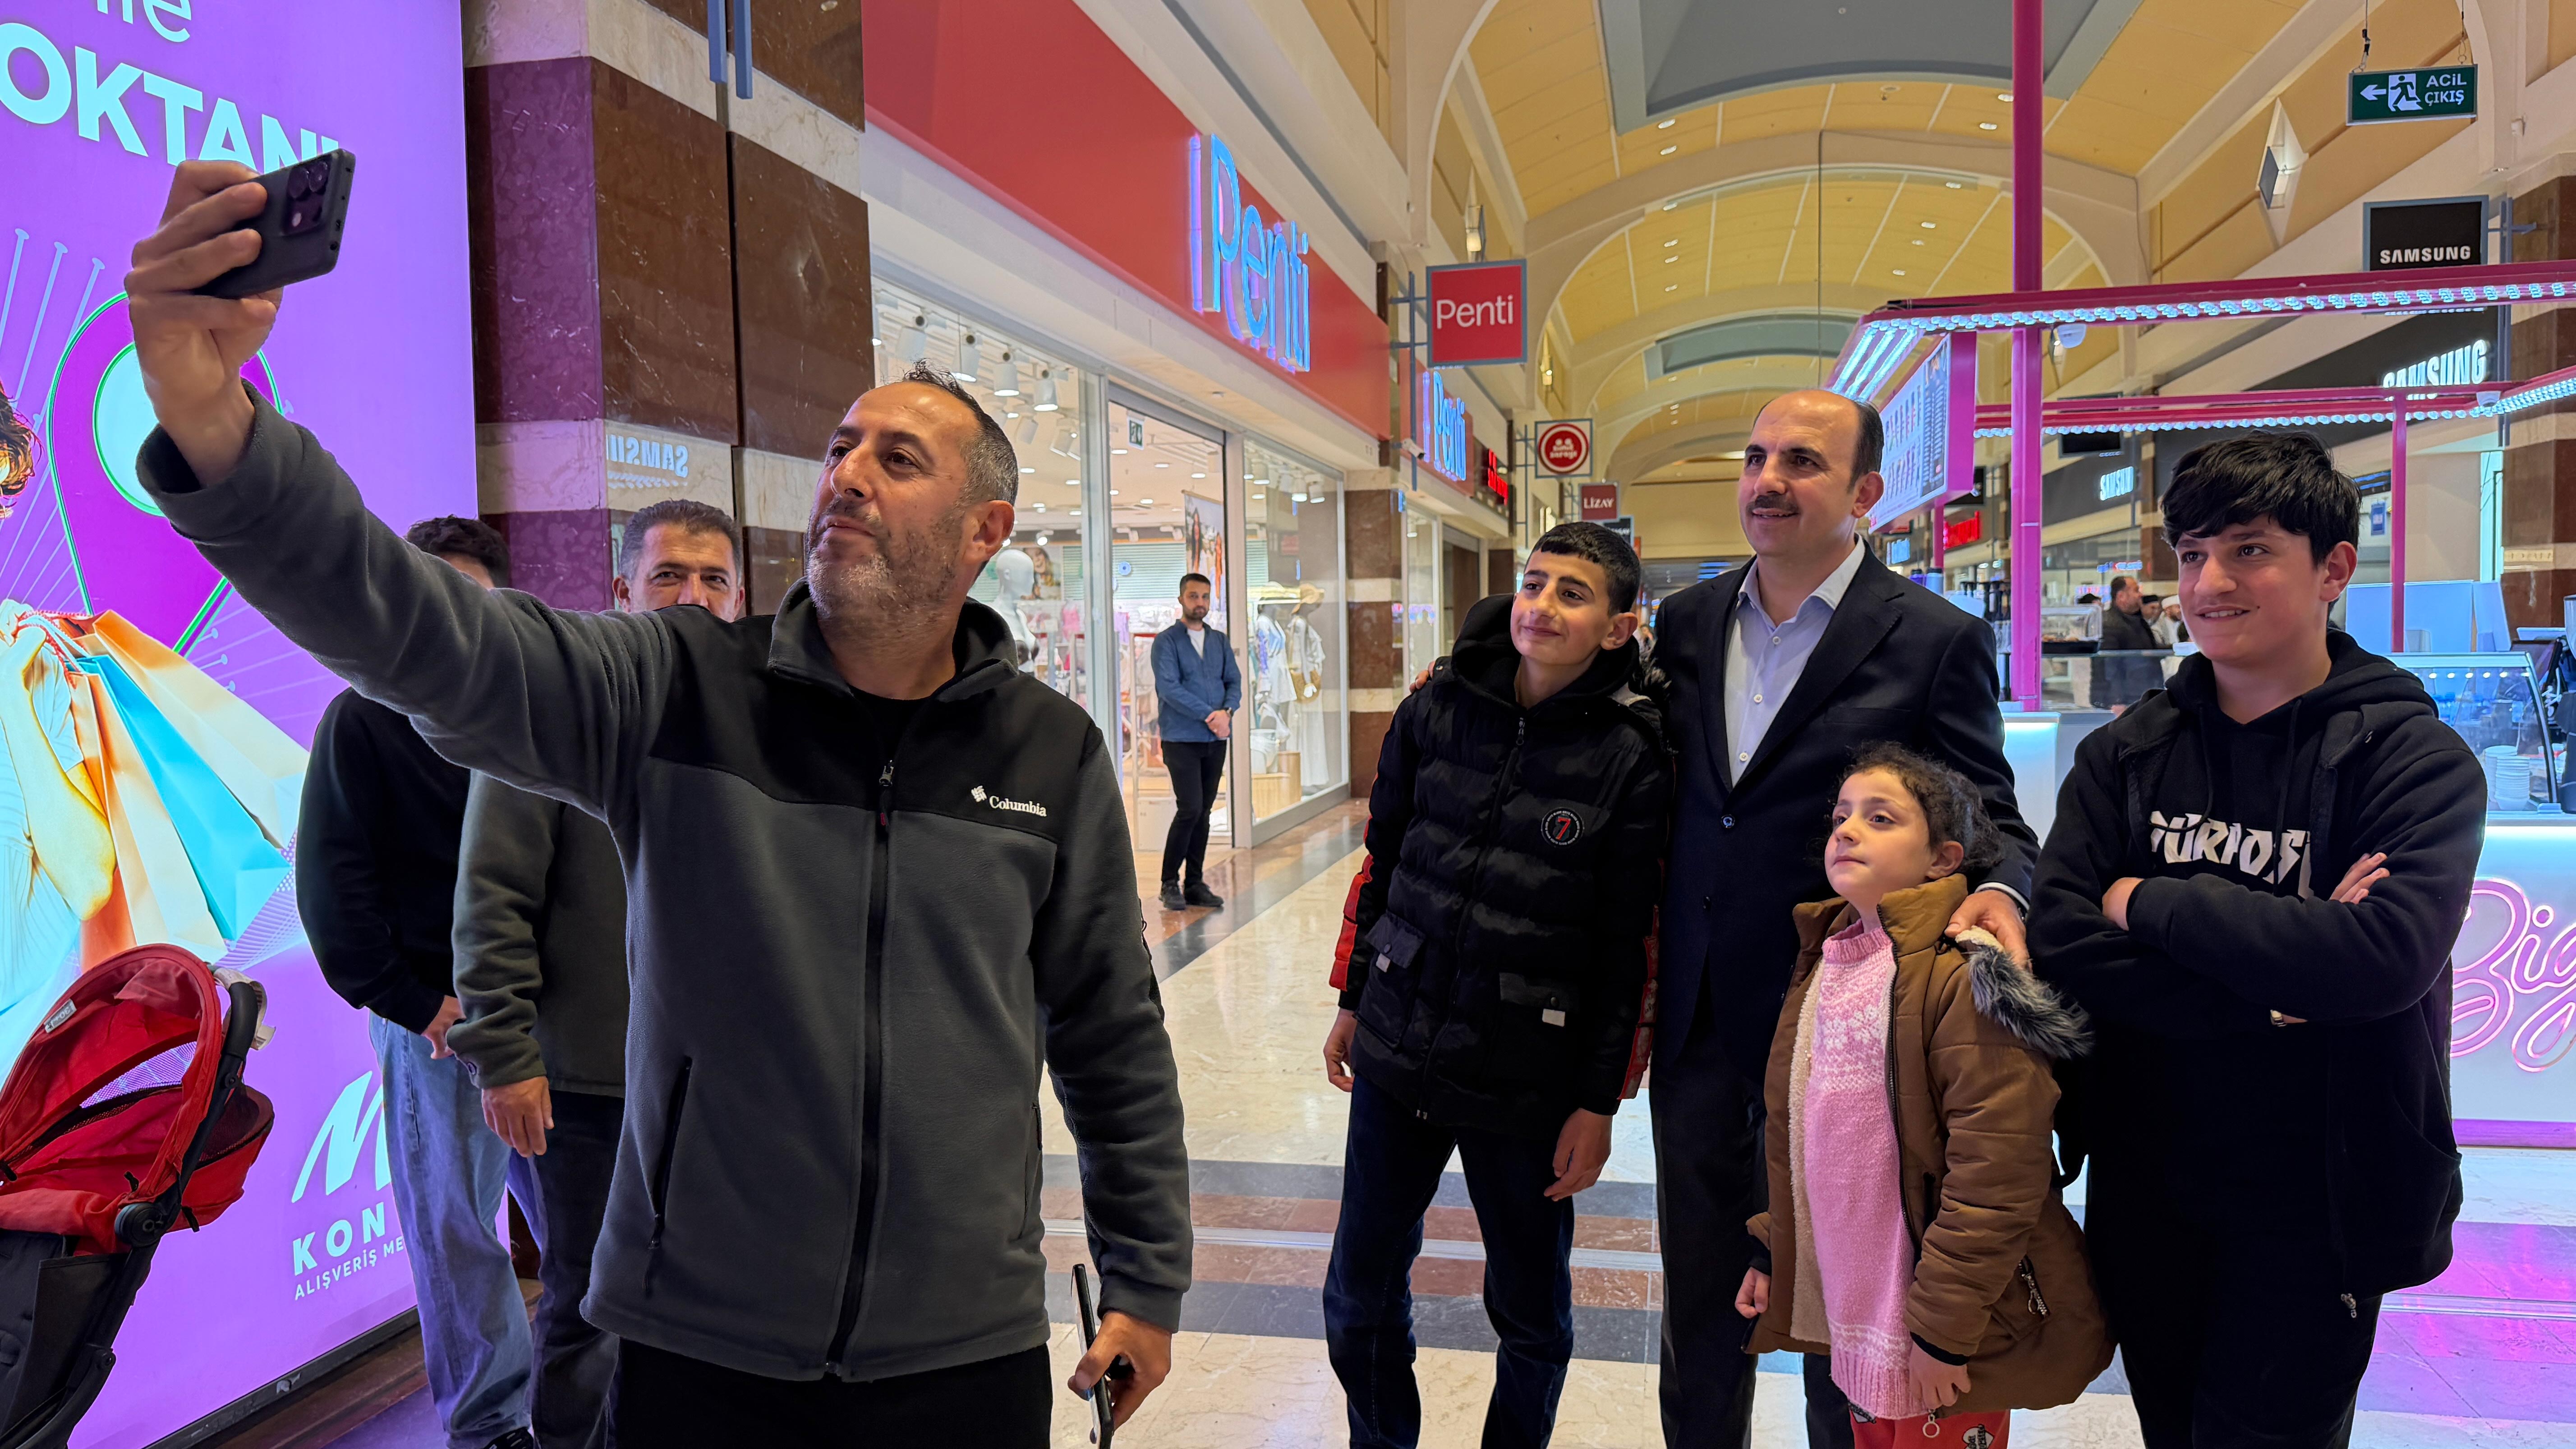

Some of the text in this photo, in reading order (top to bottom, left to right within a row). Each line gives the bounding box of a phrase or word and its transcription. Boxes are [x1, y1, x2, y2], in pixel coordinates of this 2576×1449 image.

[0, 22, 339, 175] OKTAN
[2424, 89, 2465, 106] ÇIKIŞ
[1210, 133, 1310, 373] Penti
[2380, 245, 2471, 264] SAMSUNG
[1436, 294, 1513, 329] Penti
[2383, 339, 2487, 401] SAMSUNG
[1583, 497, 1615, 509] LİZAY
[989, 796, 1047, 817] Columbia
[1555, 816, 1571, 840] 7
[294, 1249, 377, 1301] ALIŞVERİŞ
